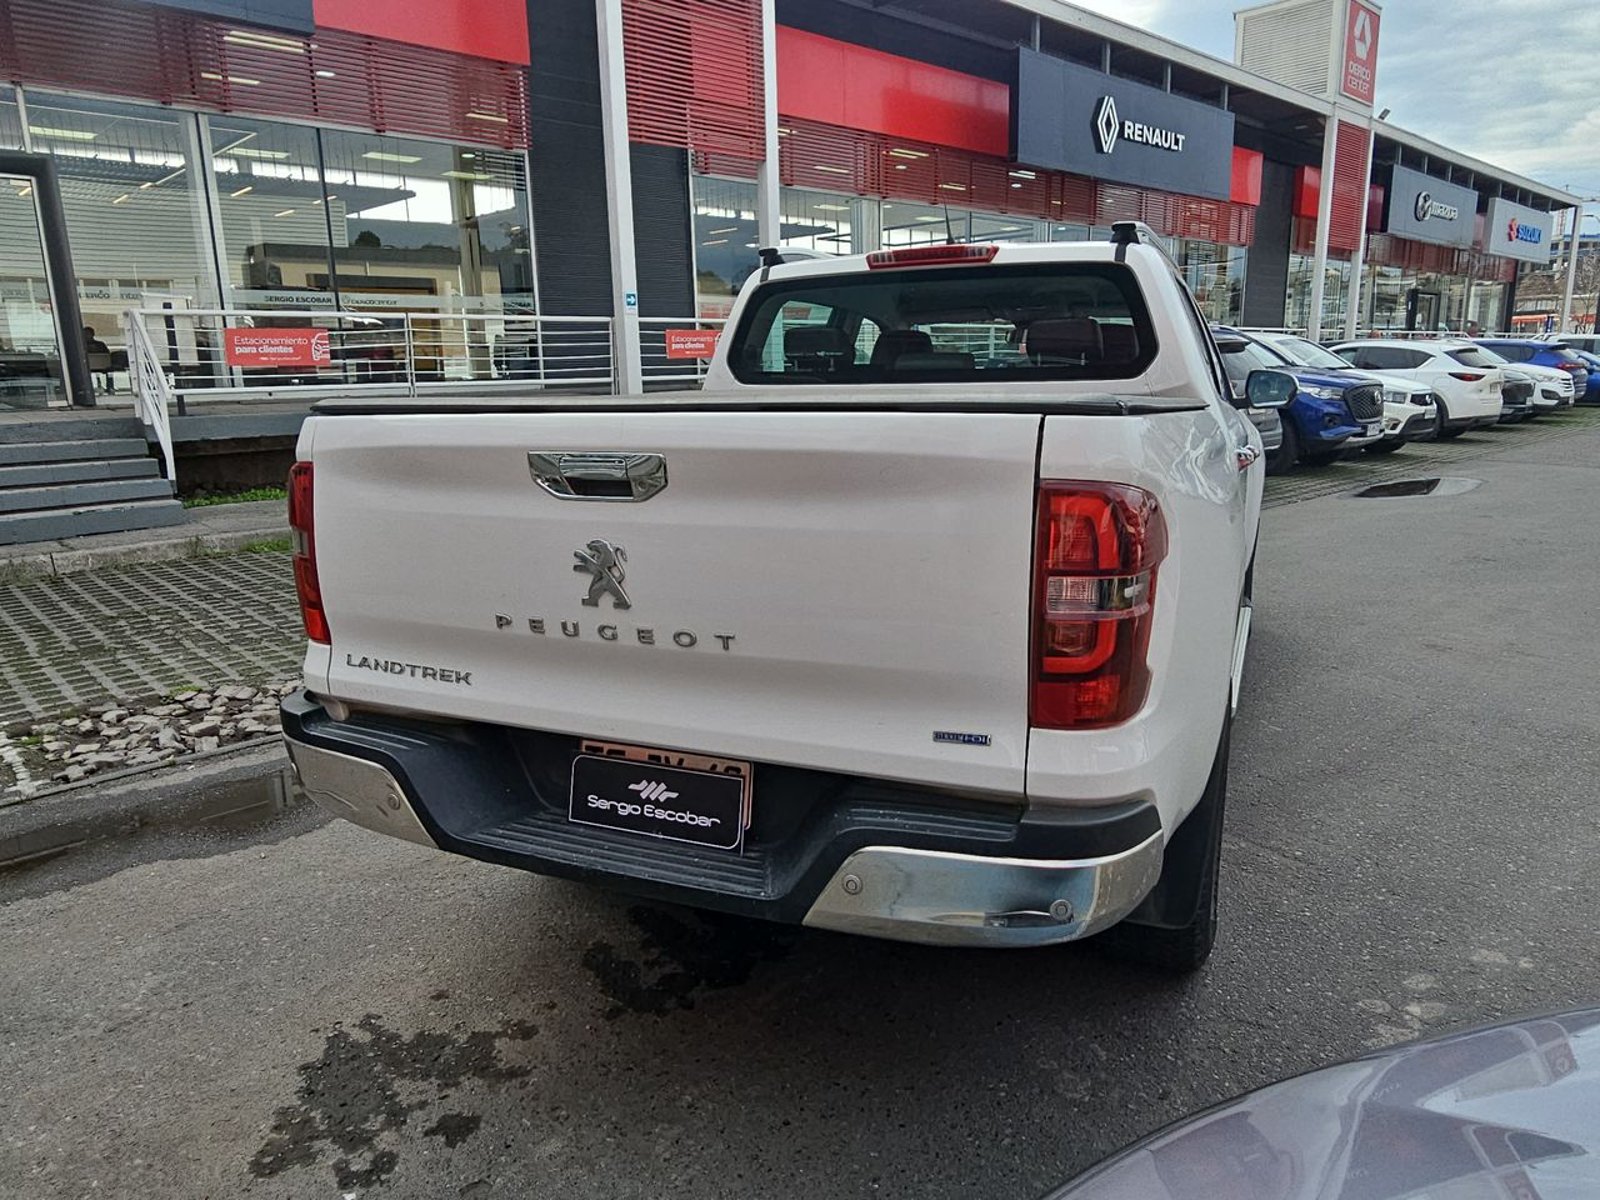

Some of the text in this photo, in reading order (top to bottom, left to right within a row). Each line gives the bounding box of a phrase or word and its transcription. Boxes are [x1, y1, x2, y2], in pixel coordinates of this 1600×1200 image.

[1124, 120, 1185, 151] RENAULT
[234, 335, 308, 345] Estacionamiento
[235, 345, 294, 355] para clientes
[495, 612, 736, 651] PEUGEOT
[346, 653, 473, 685] LANDTREK
[643, 804, 721, 828] Escobar
